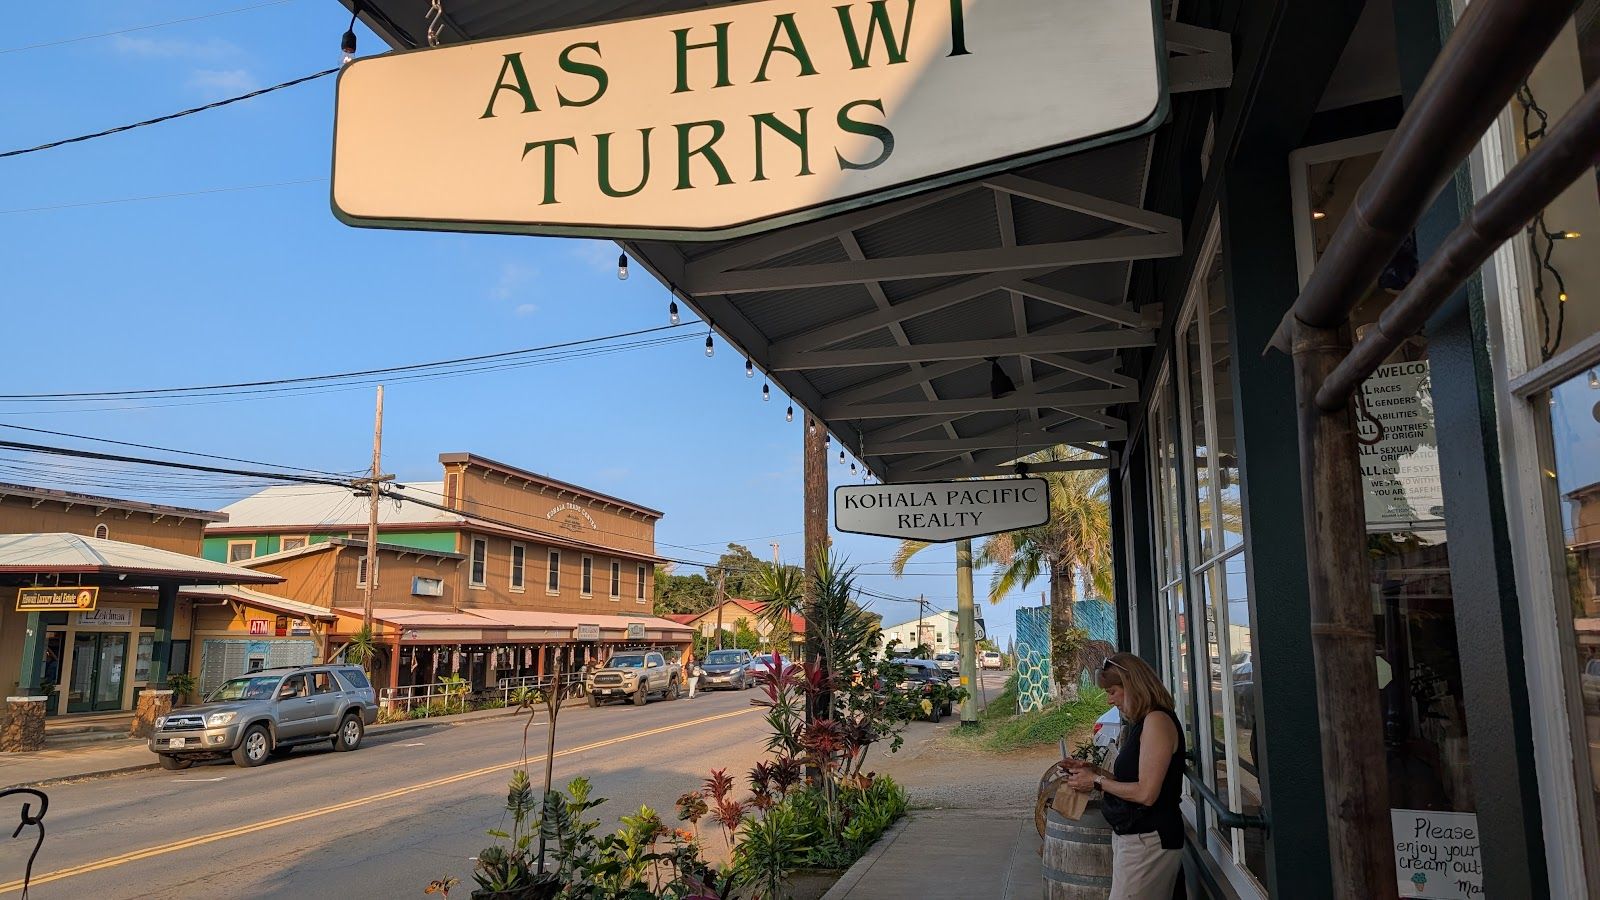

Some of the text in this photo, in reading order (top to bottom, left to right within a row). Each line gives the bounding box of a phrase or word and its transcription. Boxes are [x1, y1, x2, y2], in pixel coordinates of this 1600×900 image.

[478, 0, 974, 120] AS HAWI
[520, 98, 896, 206] TURNS
[1373, 384, 1402, 395] RACES
[1375, 396, 1417, 408] GENDERS
[1376, 410, 1418, 421] ABILITIES
[1381, 422, 1429, 433] OUNTRIES
[1391, 430, 1424, 440] ORIGIN
[1380, 445, 1415, 455] SEXUAL
[1371, 480, 1384, 488] WE
[845, 487, 1037, 509] KOHALA PACIFIC
[898, 512, 983, 528] REALTY
[52, 592, 63, 604] Real
[63, 593, 77, 604] Estate
[251, 621, 267, 633] ATM
[1414, 818, 1475, 839] Please
[1396, 840, 1480, 862] enjoy your
